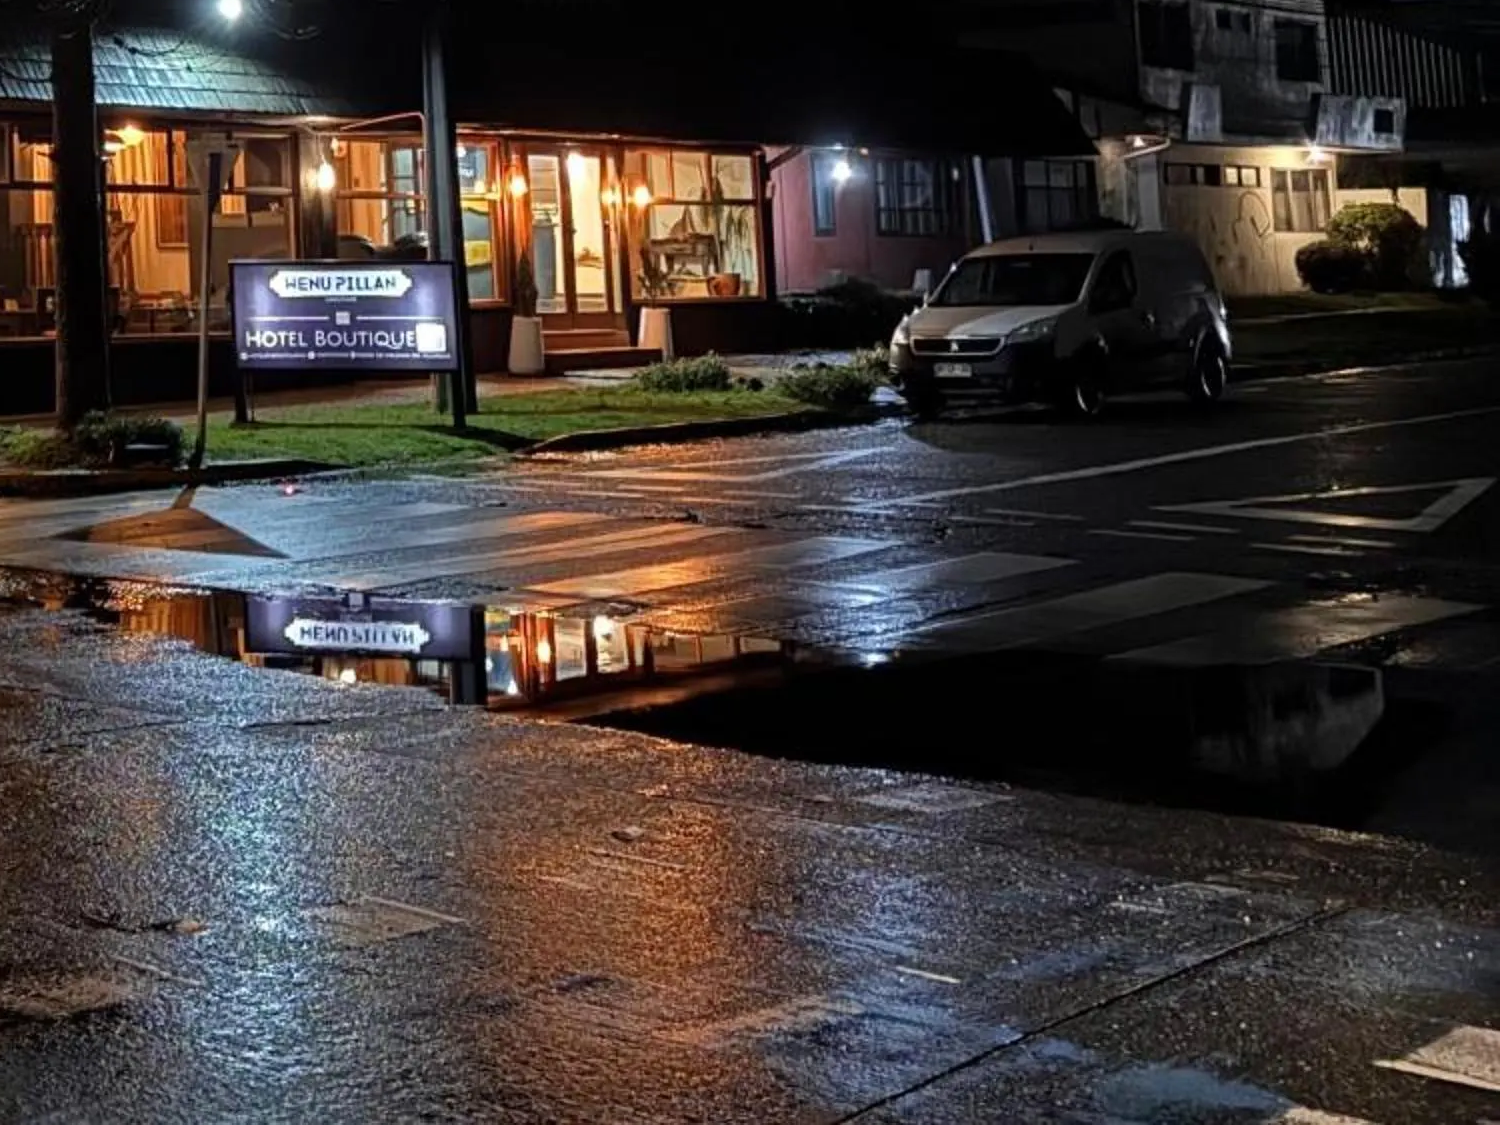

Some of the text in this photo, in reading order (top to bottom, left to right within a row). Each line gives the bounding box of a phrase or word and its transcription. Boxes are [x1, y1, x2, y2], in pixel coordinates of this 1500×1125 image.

[285, 275, 397, 292] WENU PILLAN
[245, 329, 417, 350] HOTEL BOUTIQUE
